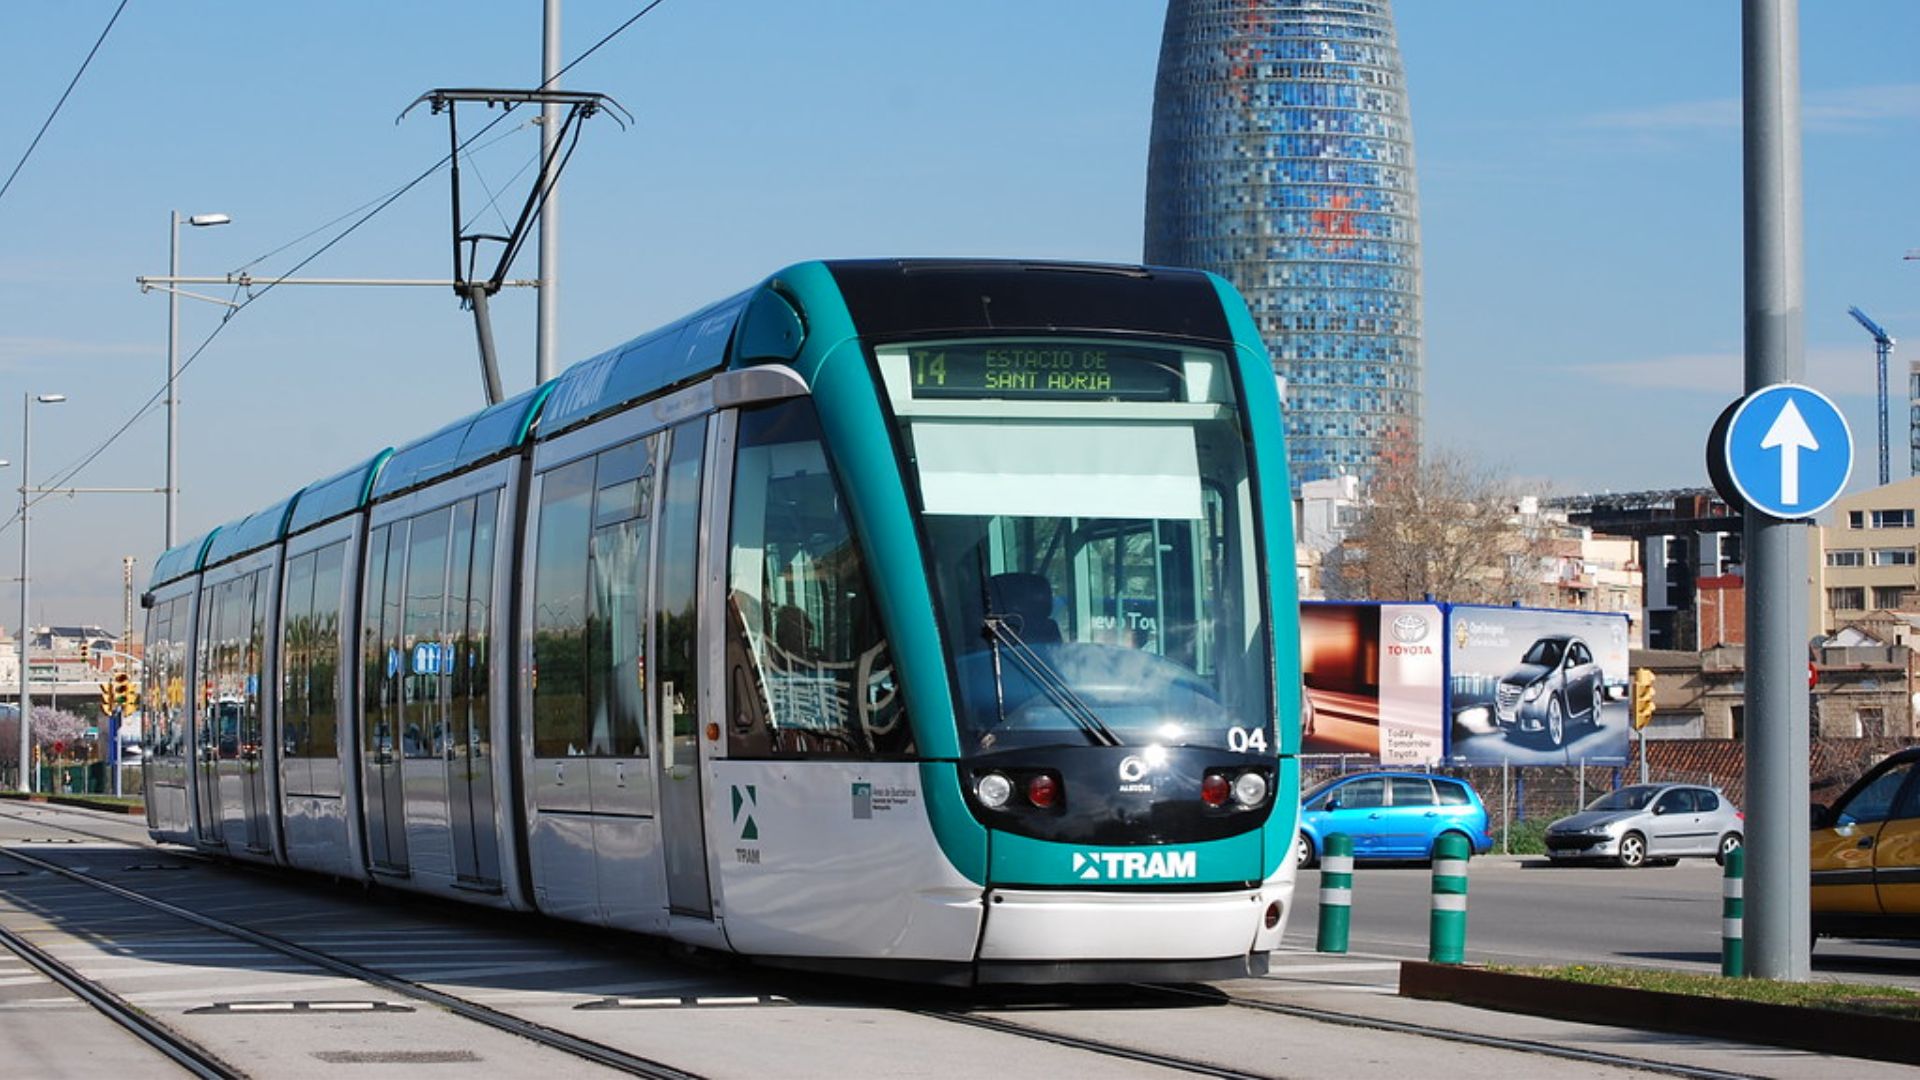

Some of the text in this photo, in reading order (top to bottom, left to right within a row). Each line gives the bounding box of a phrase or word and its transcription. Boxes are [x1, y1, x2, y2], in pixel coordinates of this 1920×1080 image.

[915, 351, 946, 385] T4
[986, 350, 1107, 370] ESTACIO DE
[985, 371, 1111, 390] SANT ADRIA
[1387, 645, 1432, 655] TOYOTA
[1228, 726, 1267, 752] 04
[1388, 728, 1415, 739] Today
[1388, 739, 1431, 747] Tomorrow
[1388, 749, 1418, 759] Toyota
[736, 848, 760, 863] TRAM
[1101, 851, 1196, 878] TRAM
